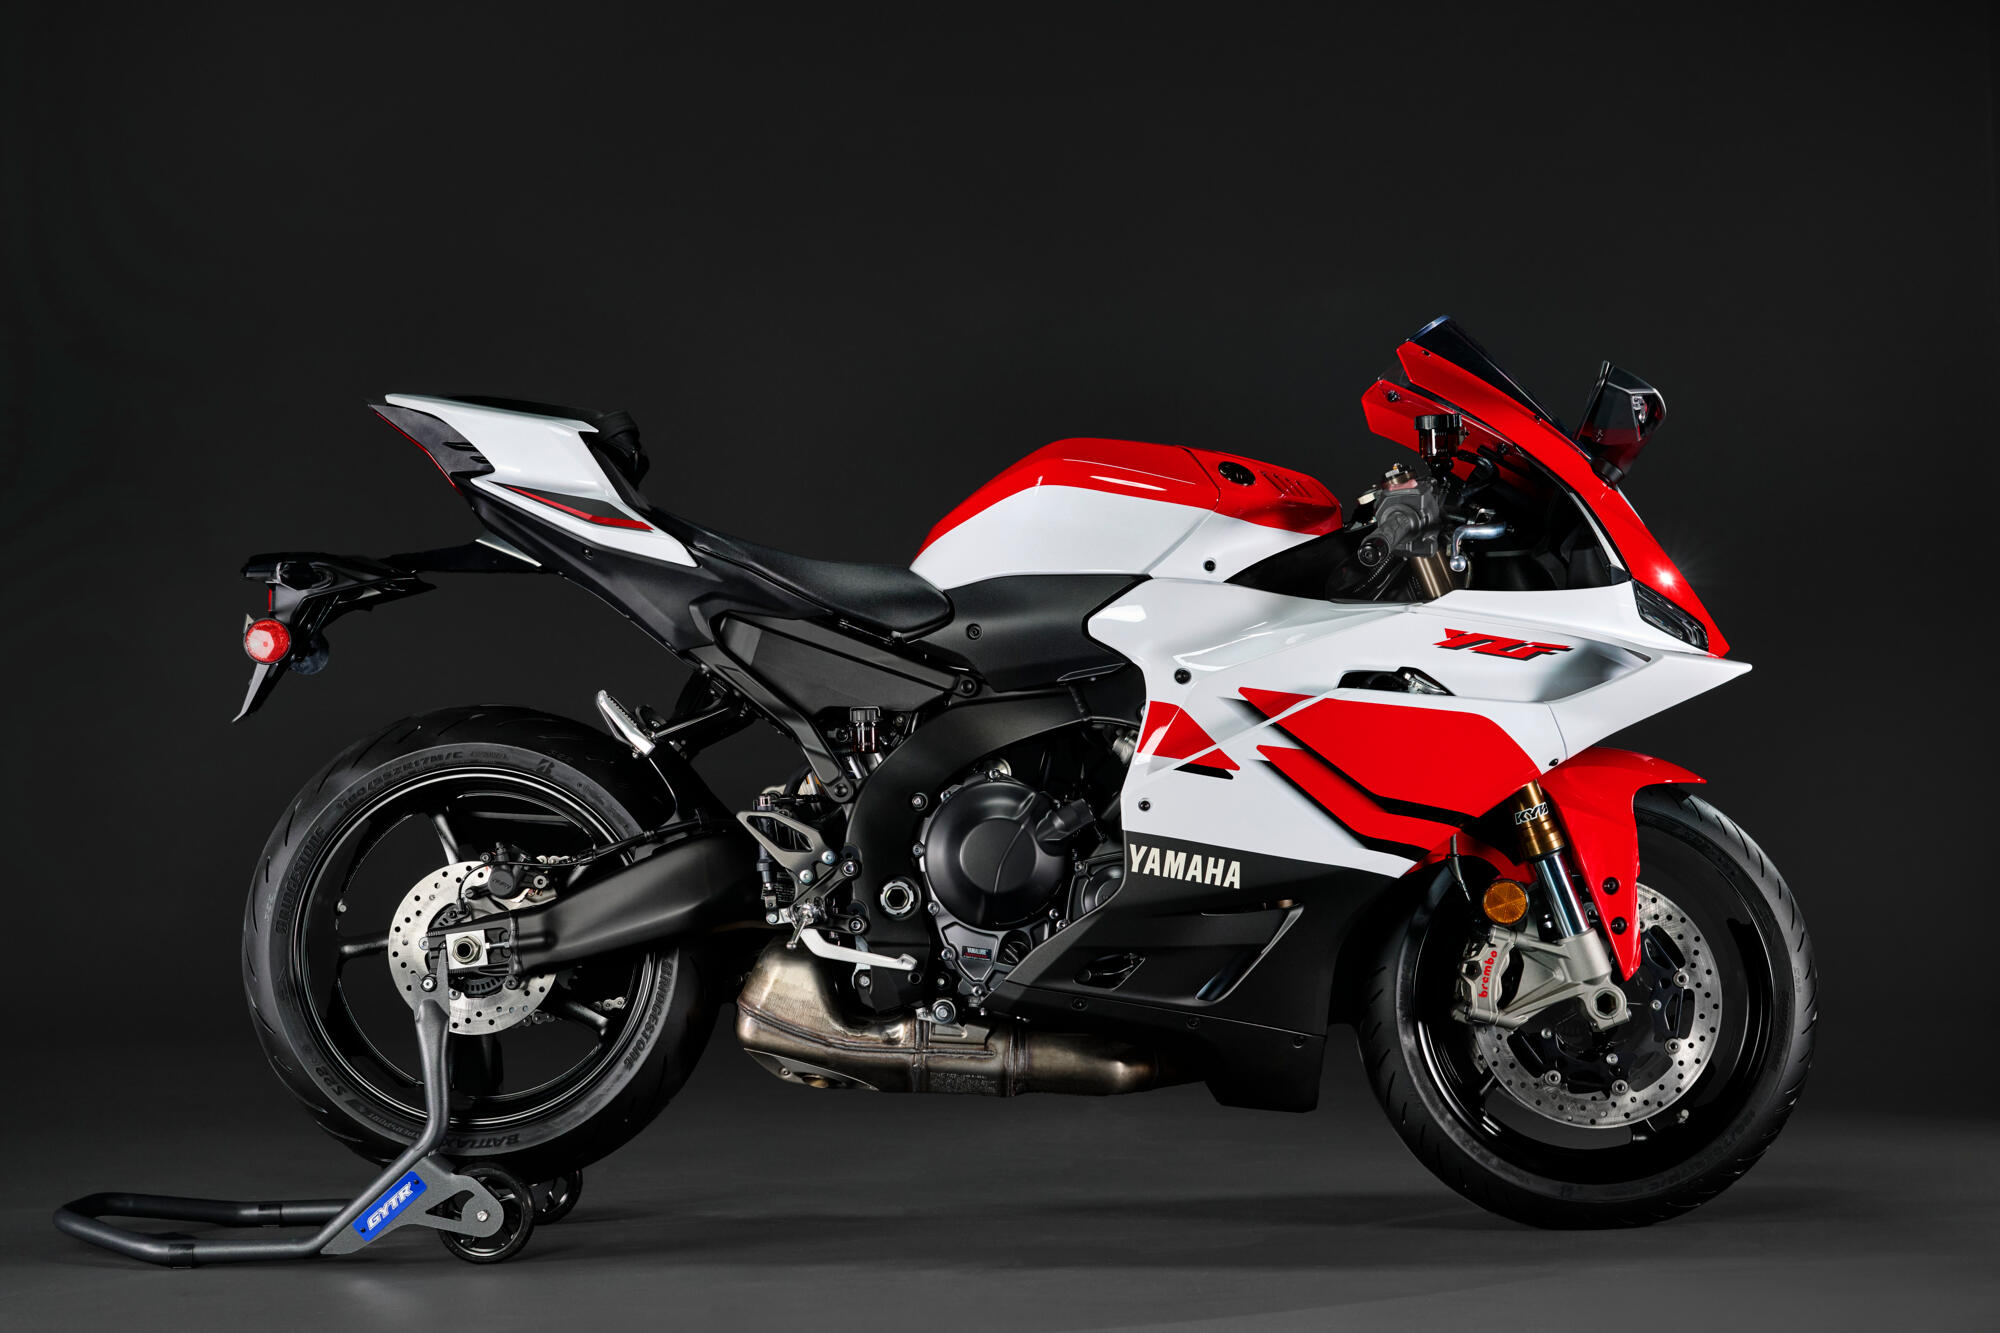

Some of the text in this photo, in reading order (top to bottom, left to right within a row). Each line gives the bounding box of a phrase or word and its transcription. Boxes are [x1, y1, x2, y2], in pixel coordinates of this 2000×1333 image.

[1433, 628, 1575, 661] YZF
[1515, 802, 1549, 825] KYB
[275, 827, 325, 935] BRIDGESTONE
[1129, 843, 1241, 889] YAMAHA
[1478, 950, 1498, 998] brembo
[623, 959, 674, 1071] BRIDGESTONE
[366, 1181, 414, 1231] GYTR
